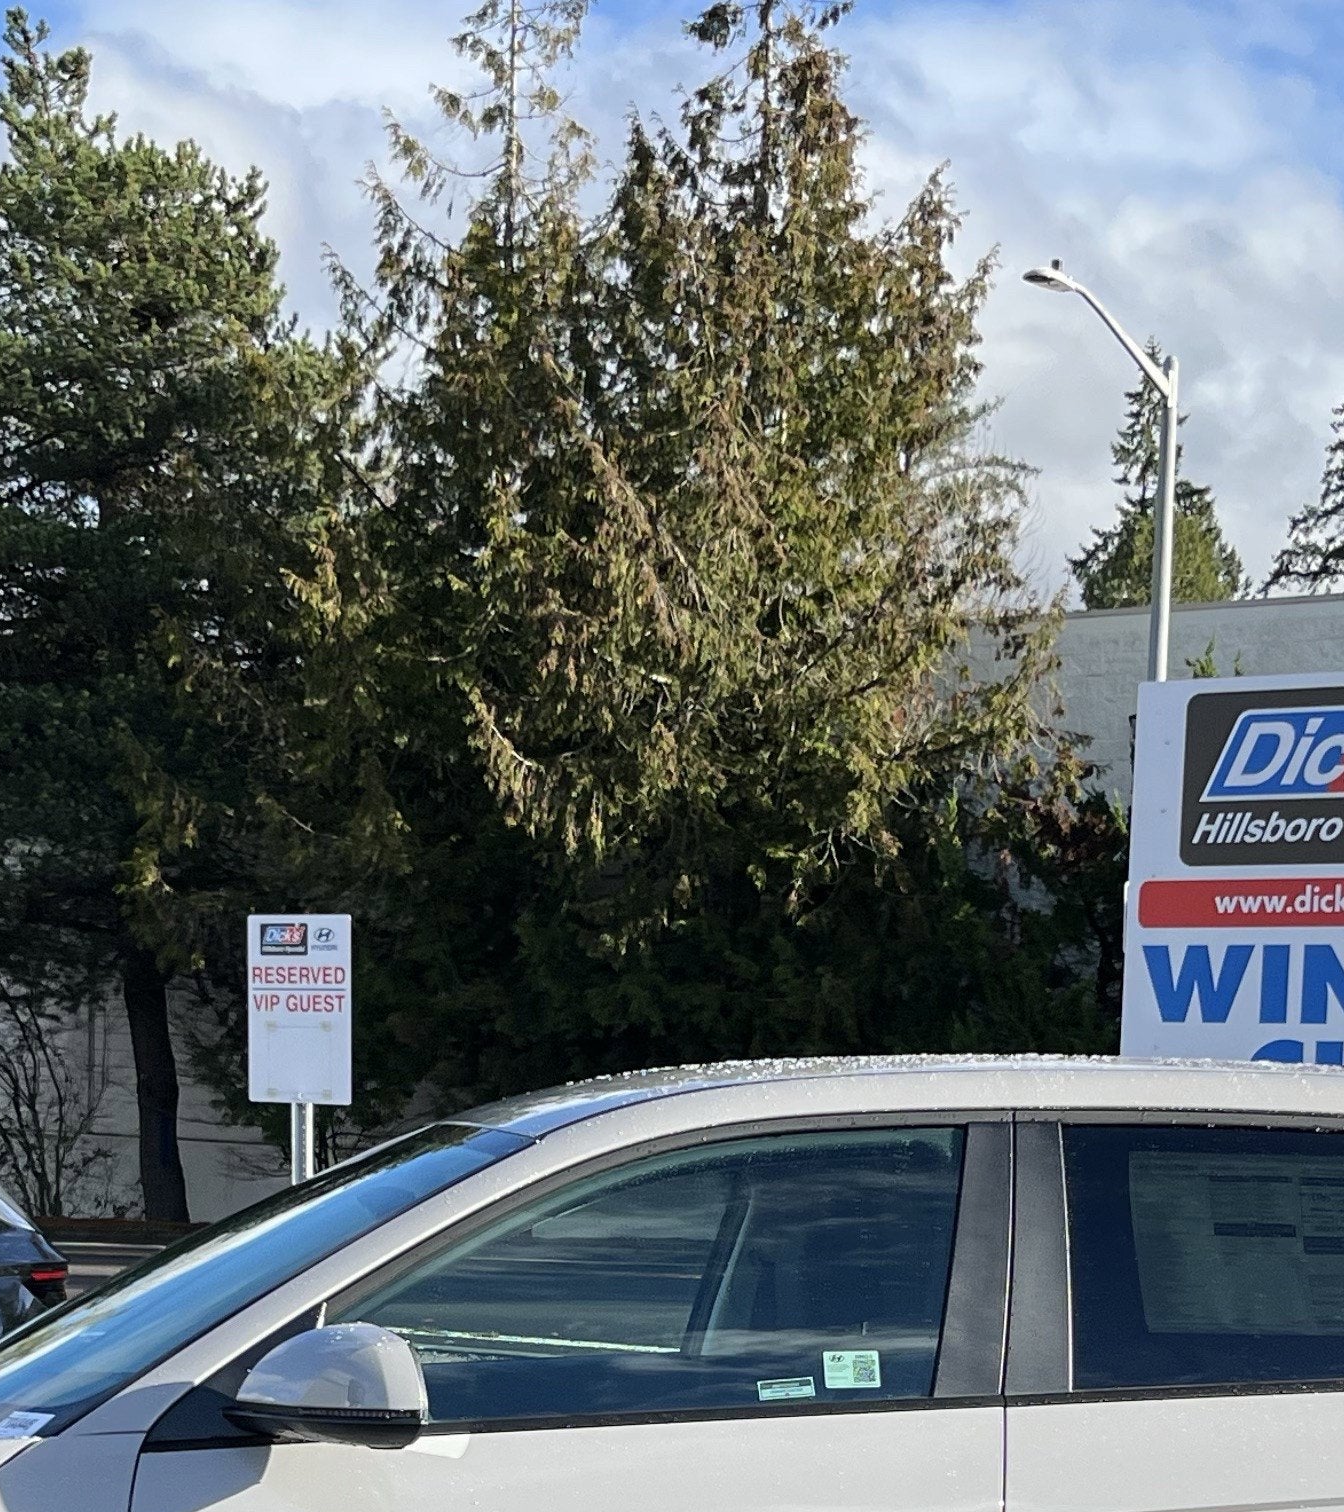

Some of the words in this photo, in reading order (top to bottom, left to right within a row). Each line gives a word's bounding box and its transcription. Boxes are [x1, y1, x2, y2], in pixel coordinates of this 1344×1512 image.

[1191, 811, 1344, 844] Hillsboro
[252, 966, 346, 985] RESERVED
[253, 994, 280, 1012] VIP
[286, 994, 346, 1013] GUEST
